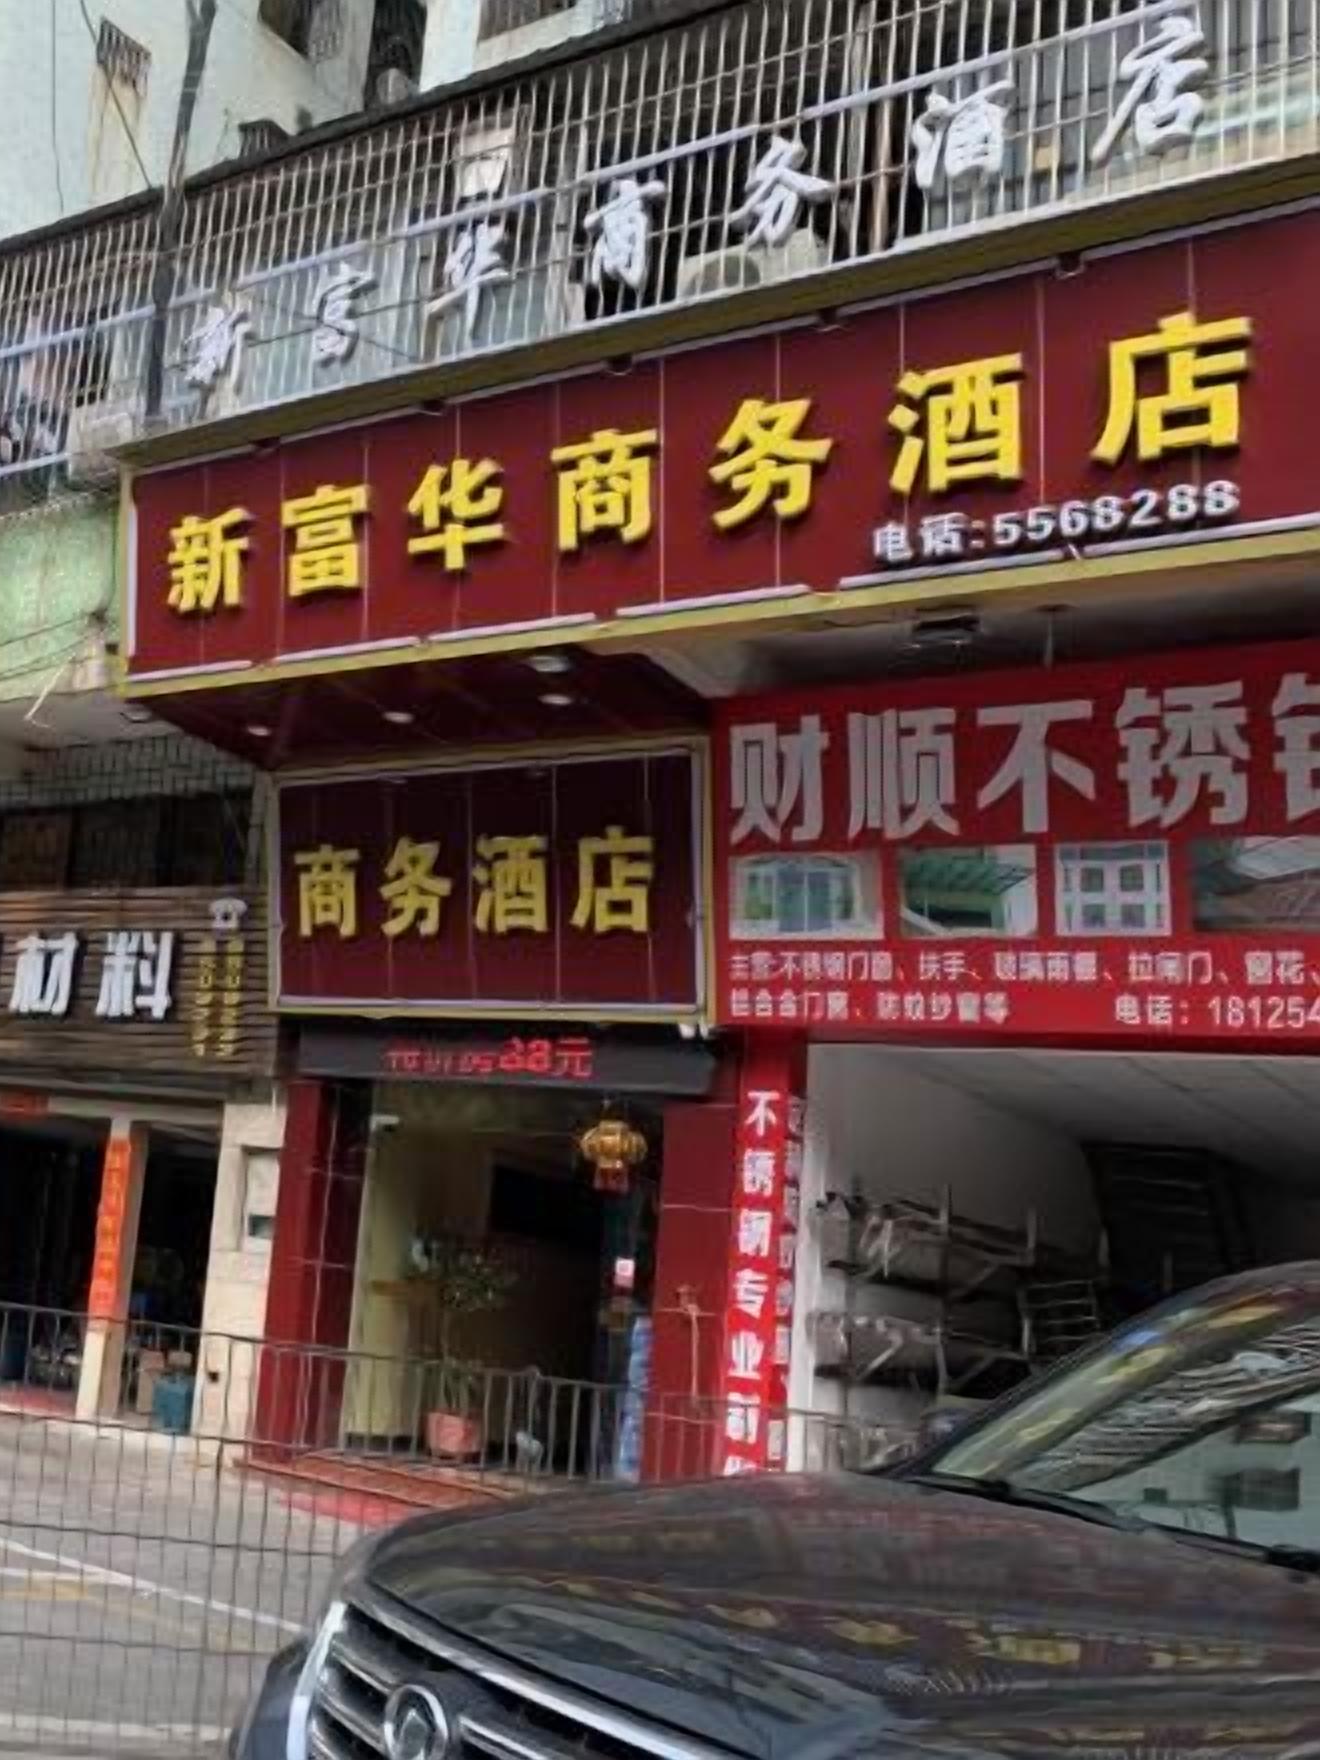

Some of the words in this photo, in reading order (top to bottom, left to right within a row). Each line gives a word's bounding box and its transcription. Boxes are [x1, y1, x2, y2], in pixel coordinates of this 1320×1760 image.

[165, 310, 1254, 615] 新富华商务酒店
[293, 824, 658, 939] 商务酒店
